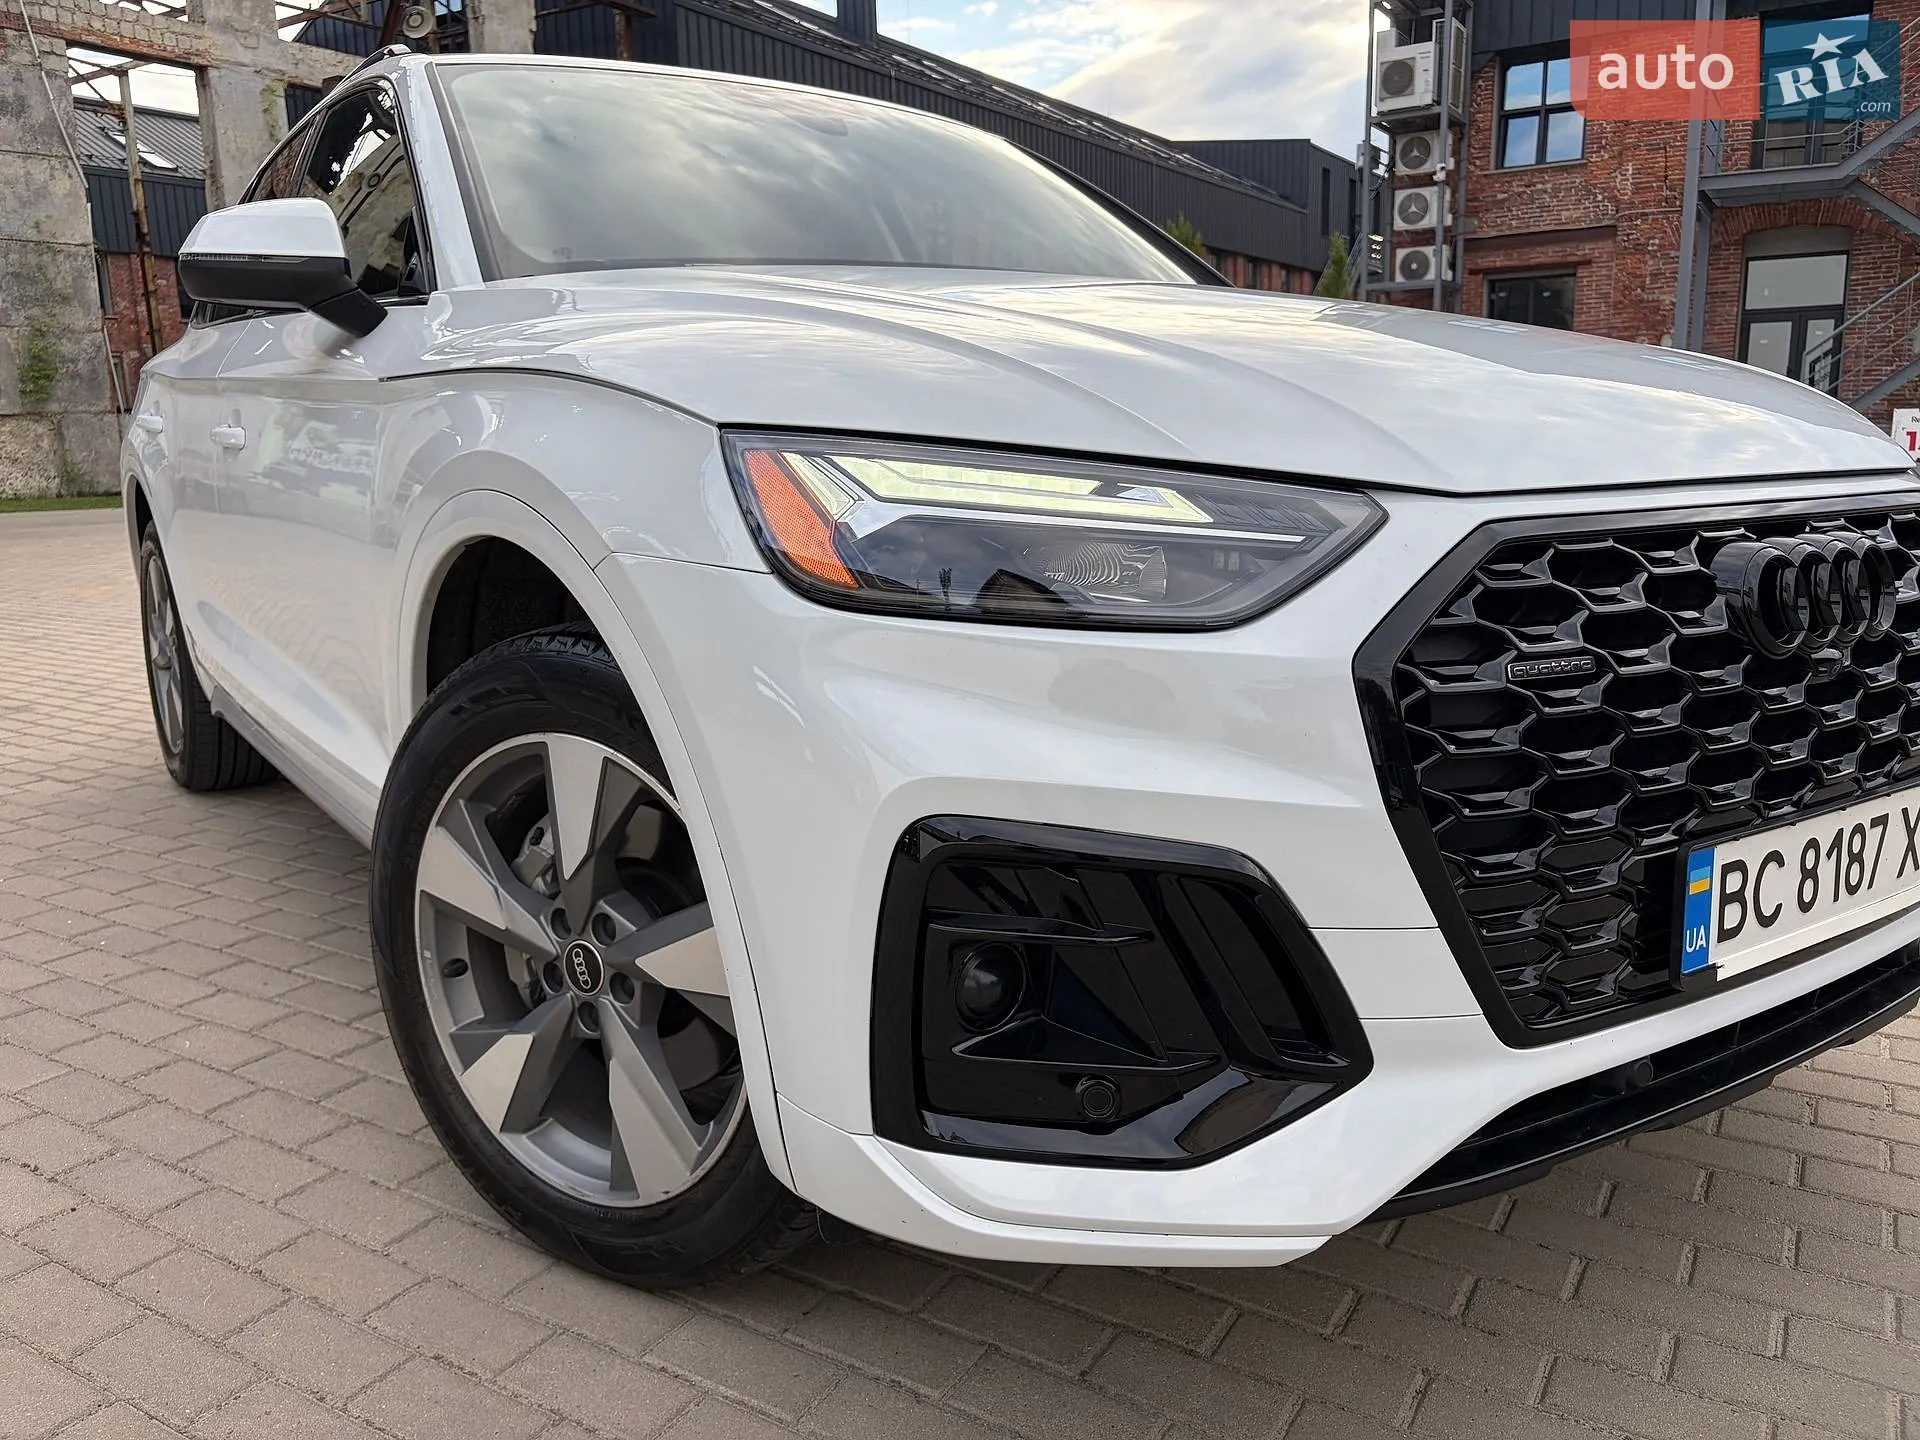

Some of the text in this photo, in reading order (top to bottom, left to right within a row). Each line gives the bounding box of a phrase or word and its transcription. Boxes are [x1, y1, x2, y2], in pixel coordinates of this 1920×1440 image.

[1513, 660, 1592, 678] quattro
[1717, 850, 1785, 944] BC
[1797, 813, 1889, 914] 8187
[1686, 925, 1706, 953] UA
